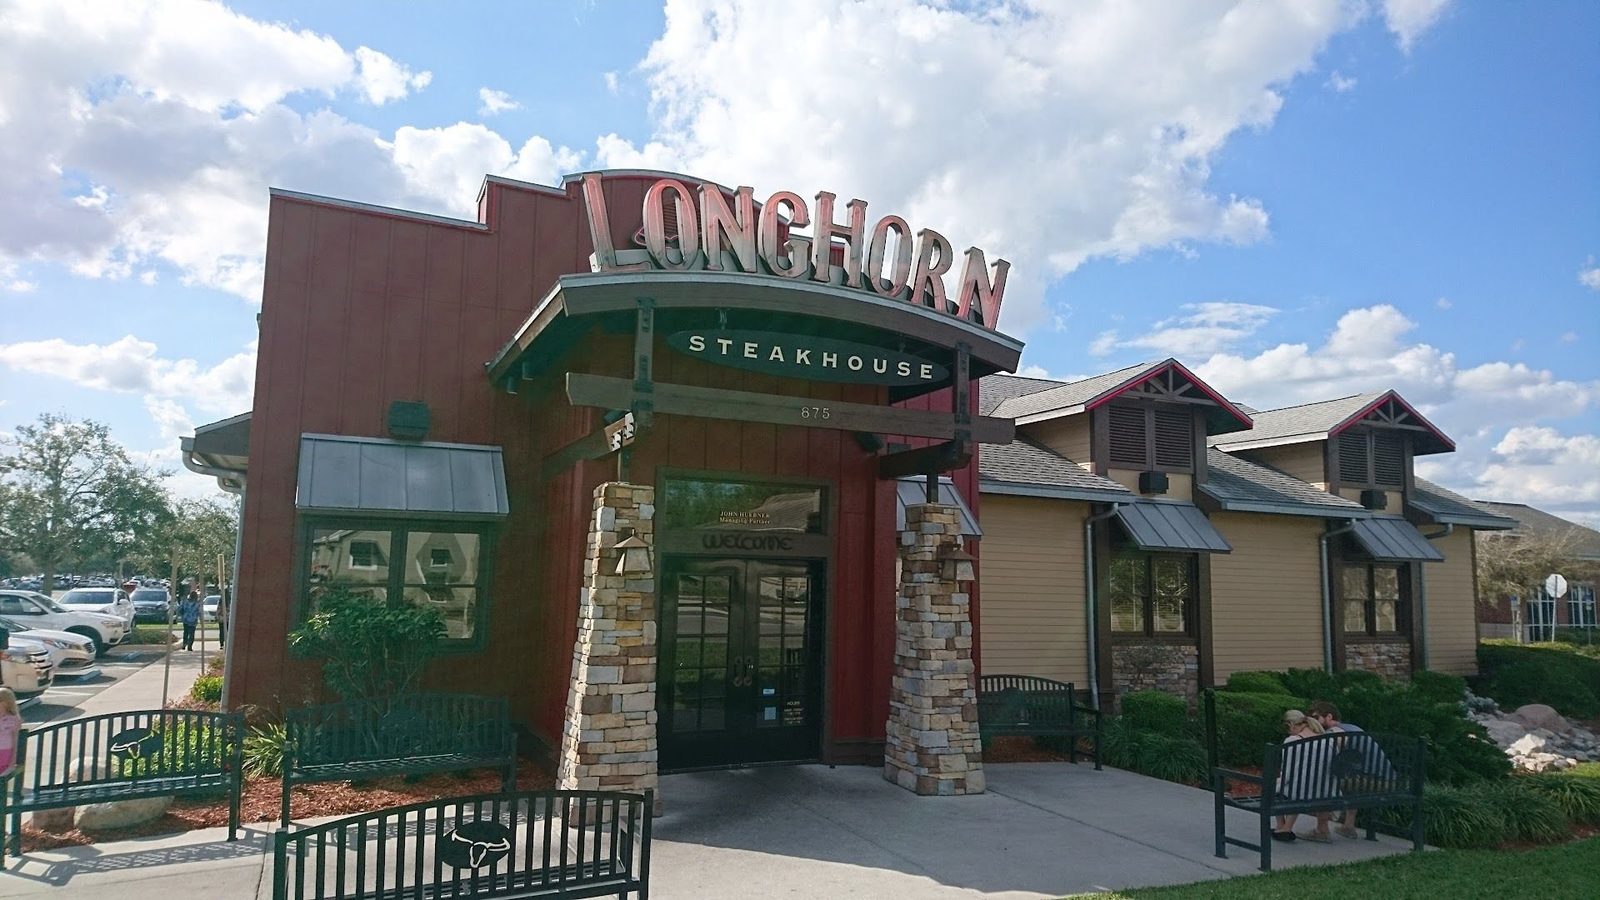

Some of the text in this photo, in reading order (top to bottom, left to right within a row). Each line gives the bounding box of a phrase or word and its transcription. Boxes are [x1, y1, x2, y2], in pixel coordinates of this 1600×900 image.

[580, 171, 1011, 332] LONGHORN
[688, 335, 933, 379] STEAKHOUSE
[800, 406, 831, 420] 875
[702, 533, 793, 551] WELCOME
